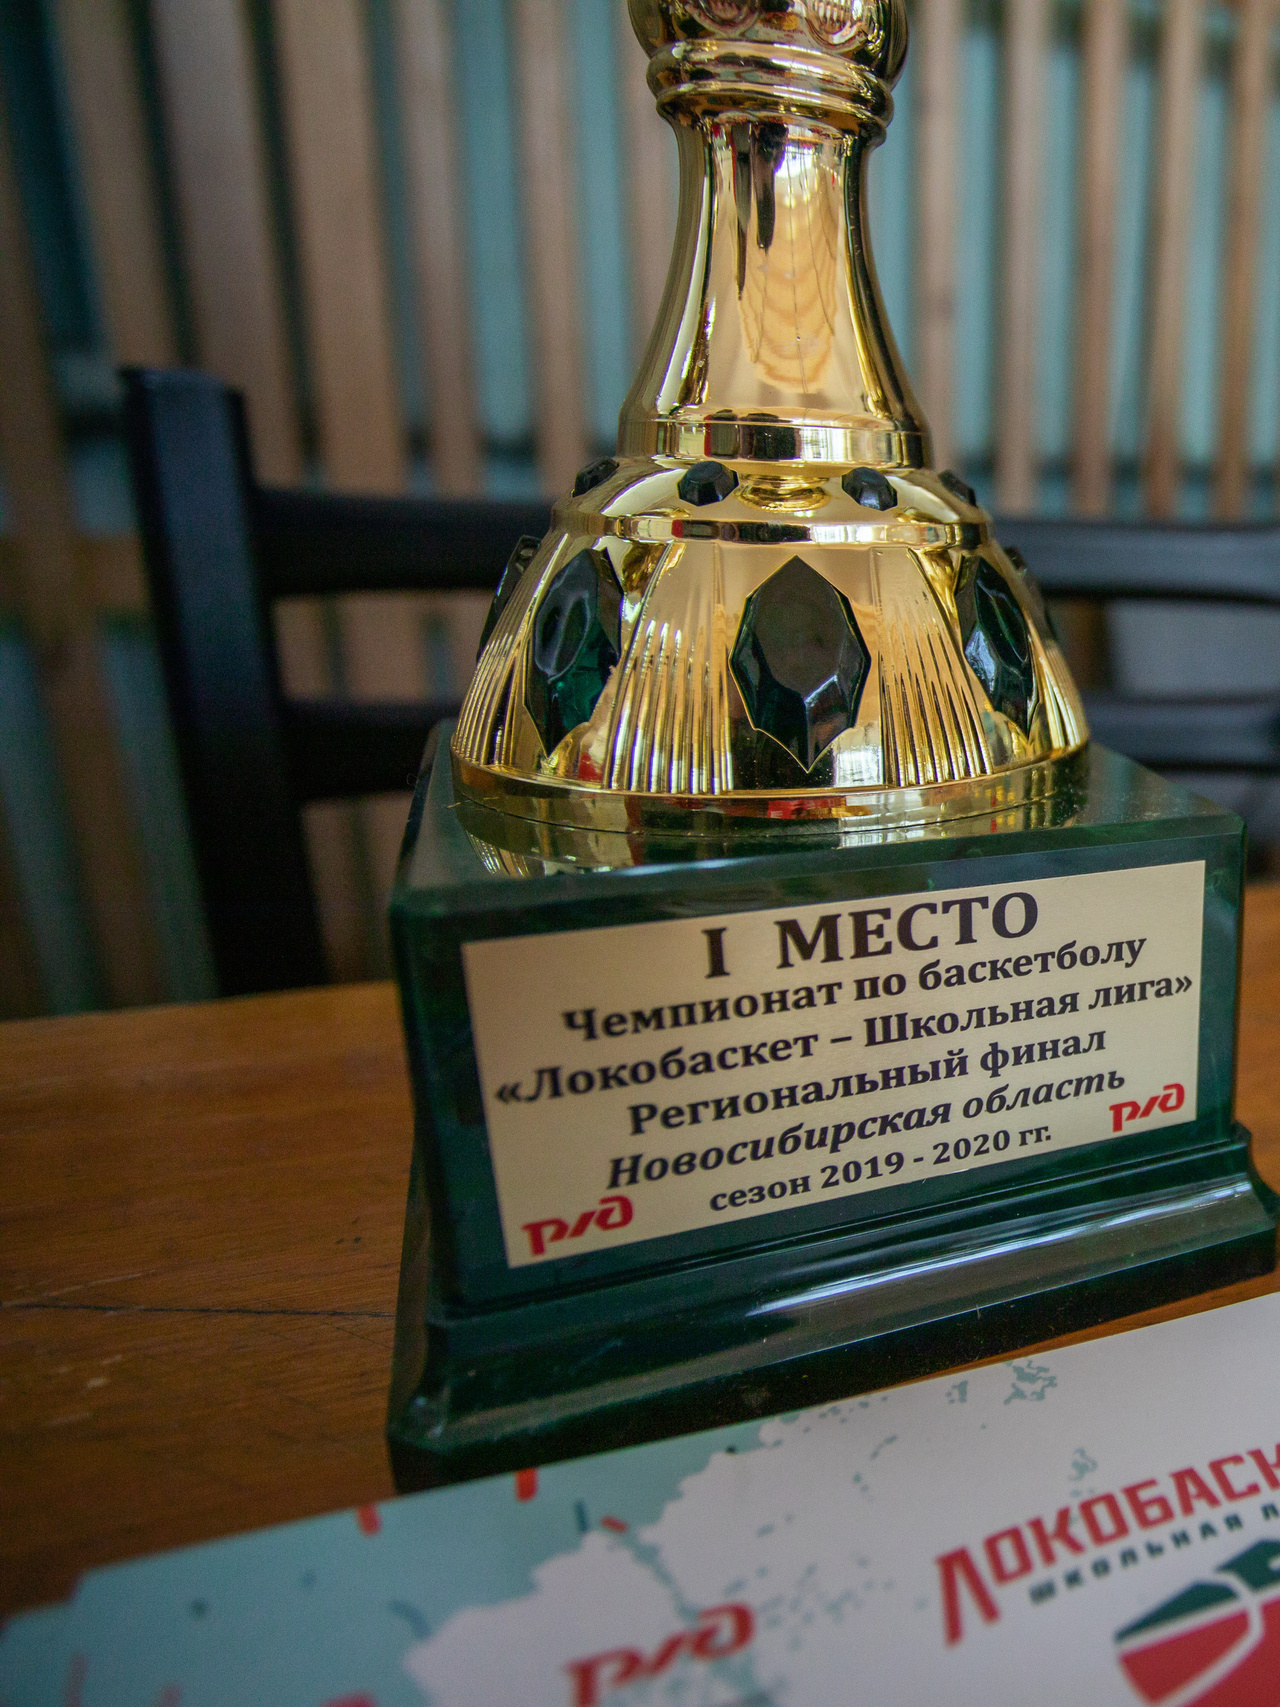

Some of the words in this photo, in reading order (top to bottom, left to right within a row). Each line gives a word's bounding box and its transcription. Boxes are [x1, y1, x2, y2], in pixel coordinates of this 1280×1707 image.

[702, 927, 731, 979] I
[774, 891, 1039, 970] МЕСТО
[495, 1033, 819, 1105] «Локобаскет
[864, 991, 1081, 1047] Школьная
[1088, 975, 1194, 1010] лига»
[562, 981, 843, 1042] Чемпионат
[854, 972, 907, 1001] по
[918, 937, 1148, 993] баскетболу
[605, 1102, 952, 1191] Новосибирская
[962, 1070, 1126, 1115] область
[627, 1048, 969, 1137] Региональный
[979, 1030, 1107, 1078] финал
[708, 1175, 812, 1213] сезон
[820, 1151, 905, 1189] 2019
[932, 1129, 1011, 1165] 2020
[1018, 1125, 1052, 1146] гг.
[1029, 1512, 1244, 1605] ШКОЛЬНАЯ
